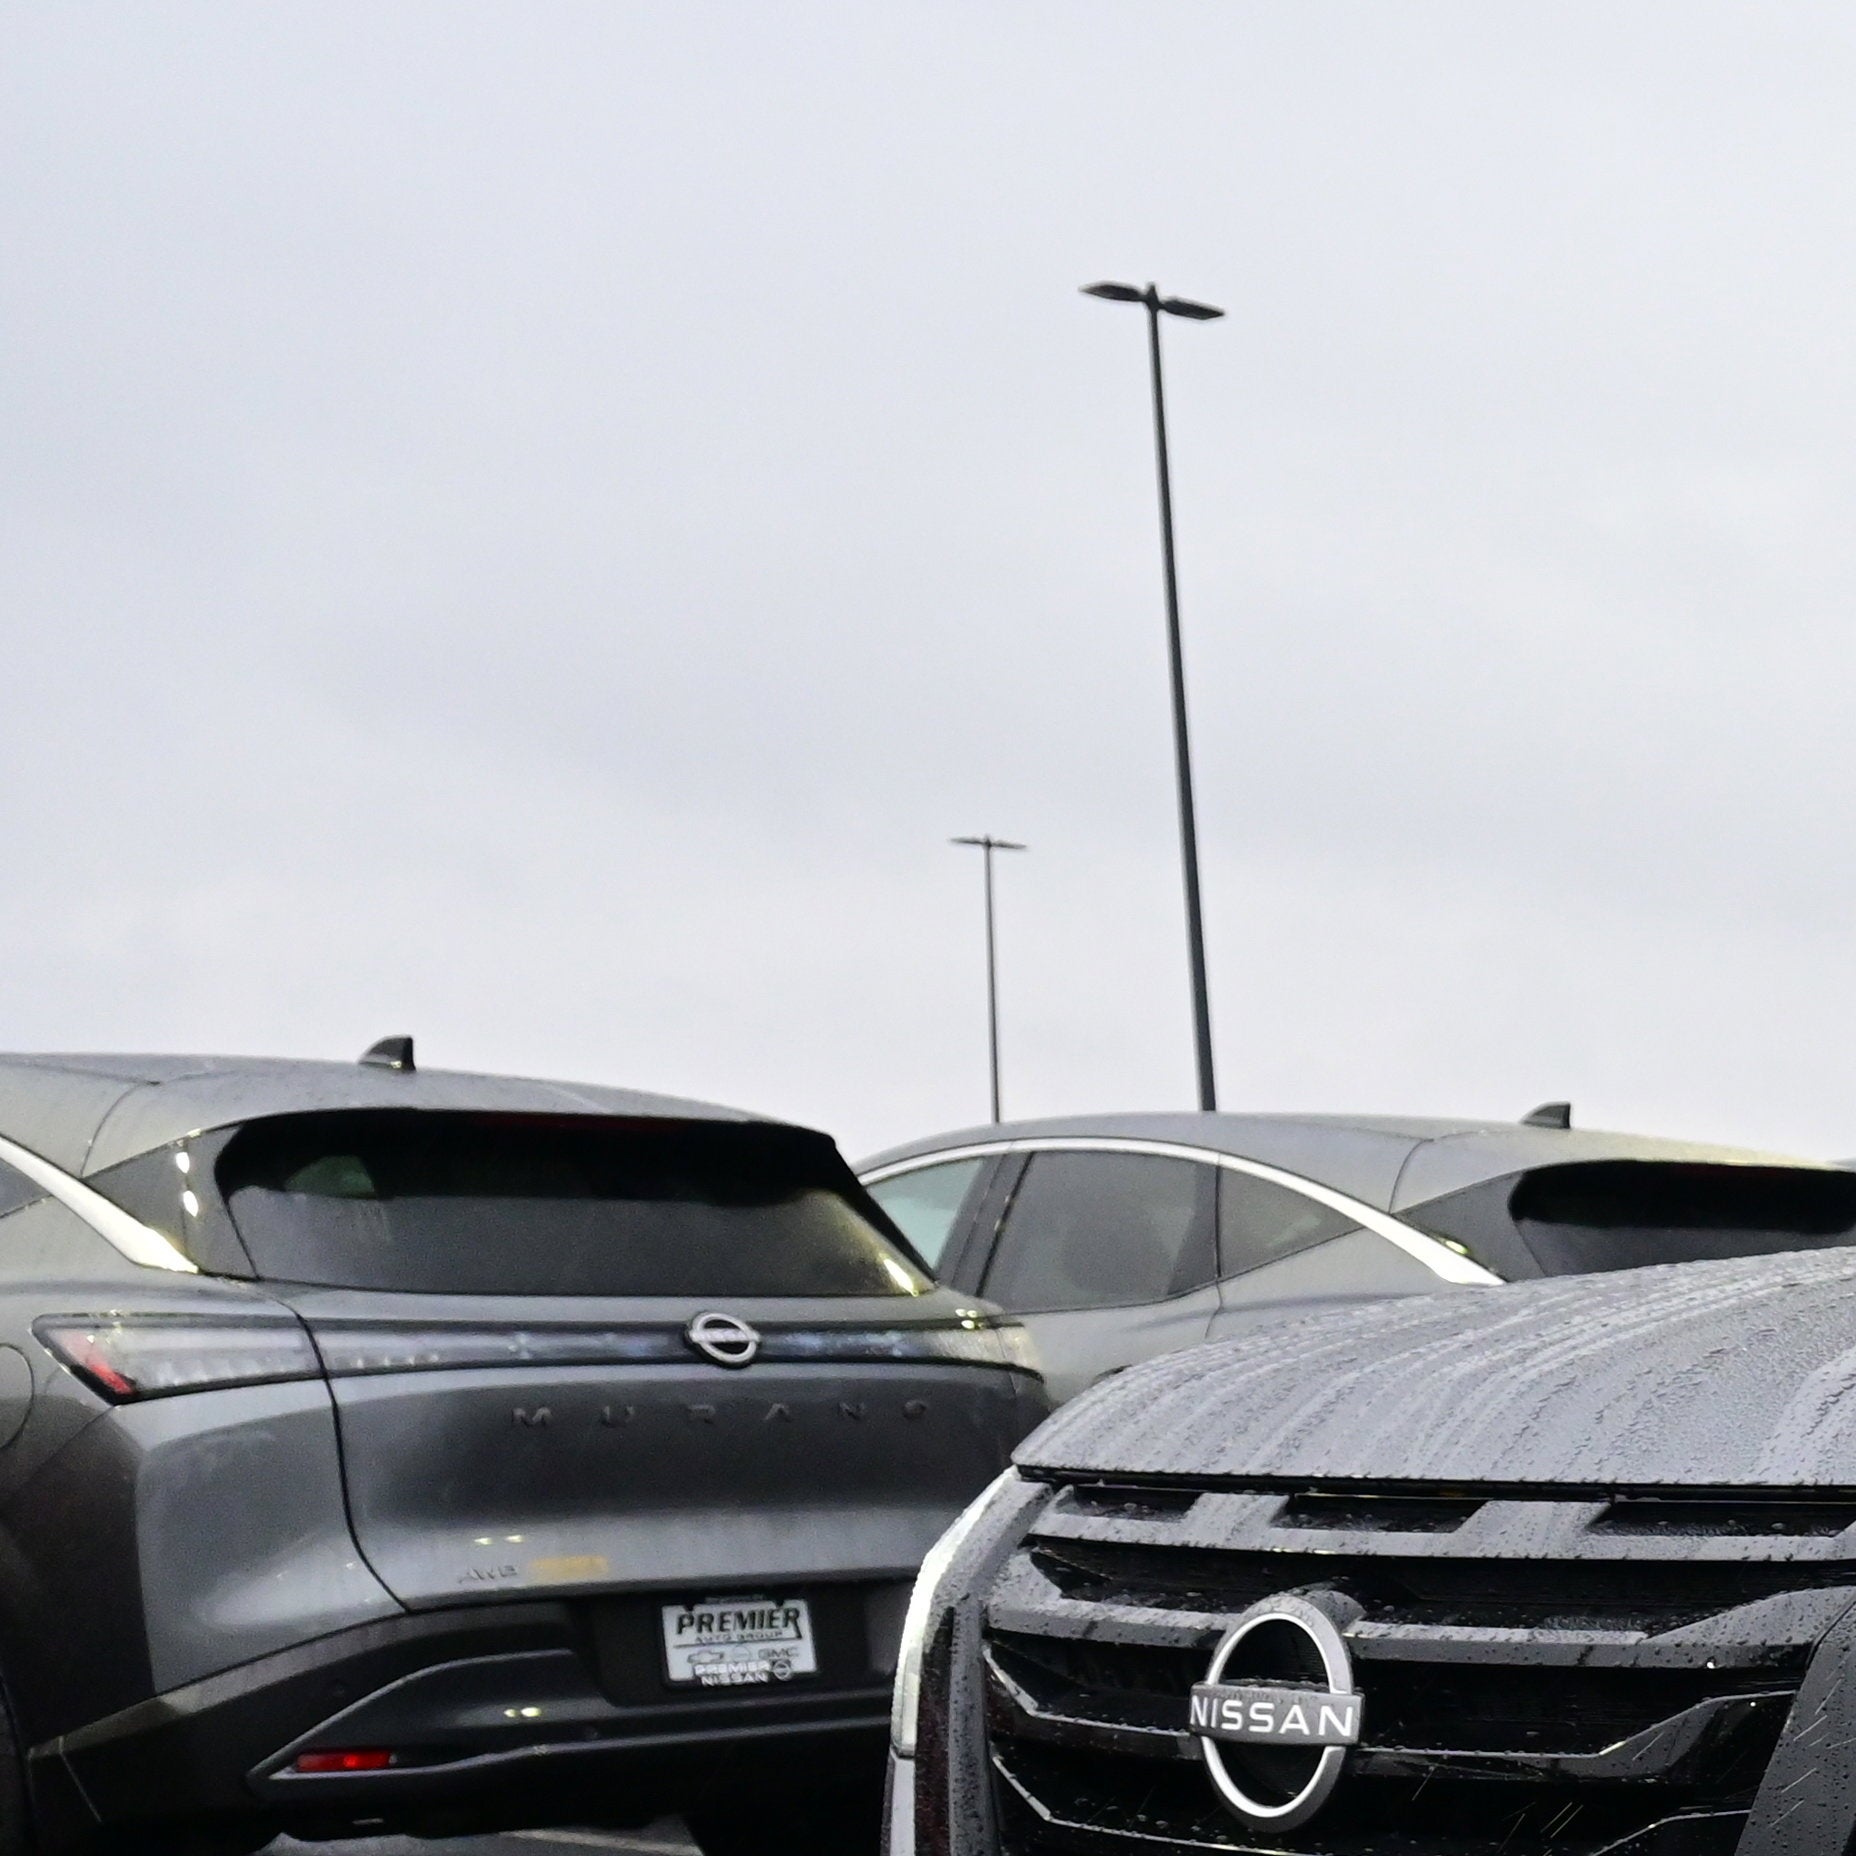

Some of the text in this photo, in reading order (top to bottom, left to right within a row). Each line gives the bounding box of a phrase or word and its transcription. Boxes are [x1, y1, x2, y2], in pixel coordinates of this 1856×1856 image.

[511, 1400, 928, 1428] MURANO
[676, 1607, 802, 1639] PREMIER
[701, 1671, 769, 1687] NISSAN
[1190, 1695, 1354, 1737] NISSAN
